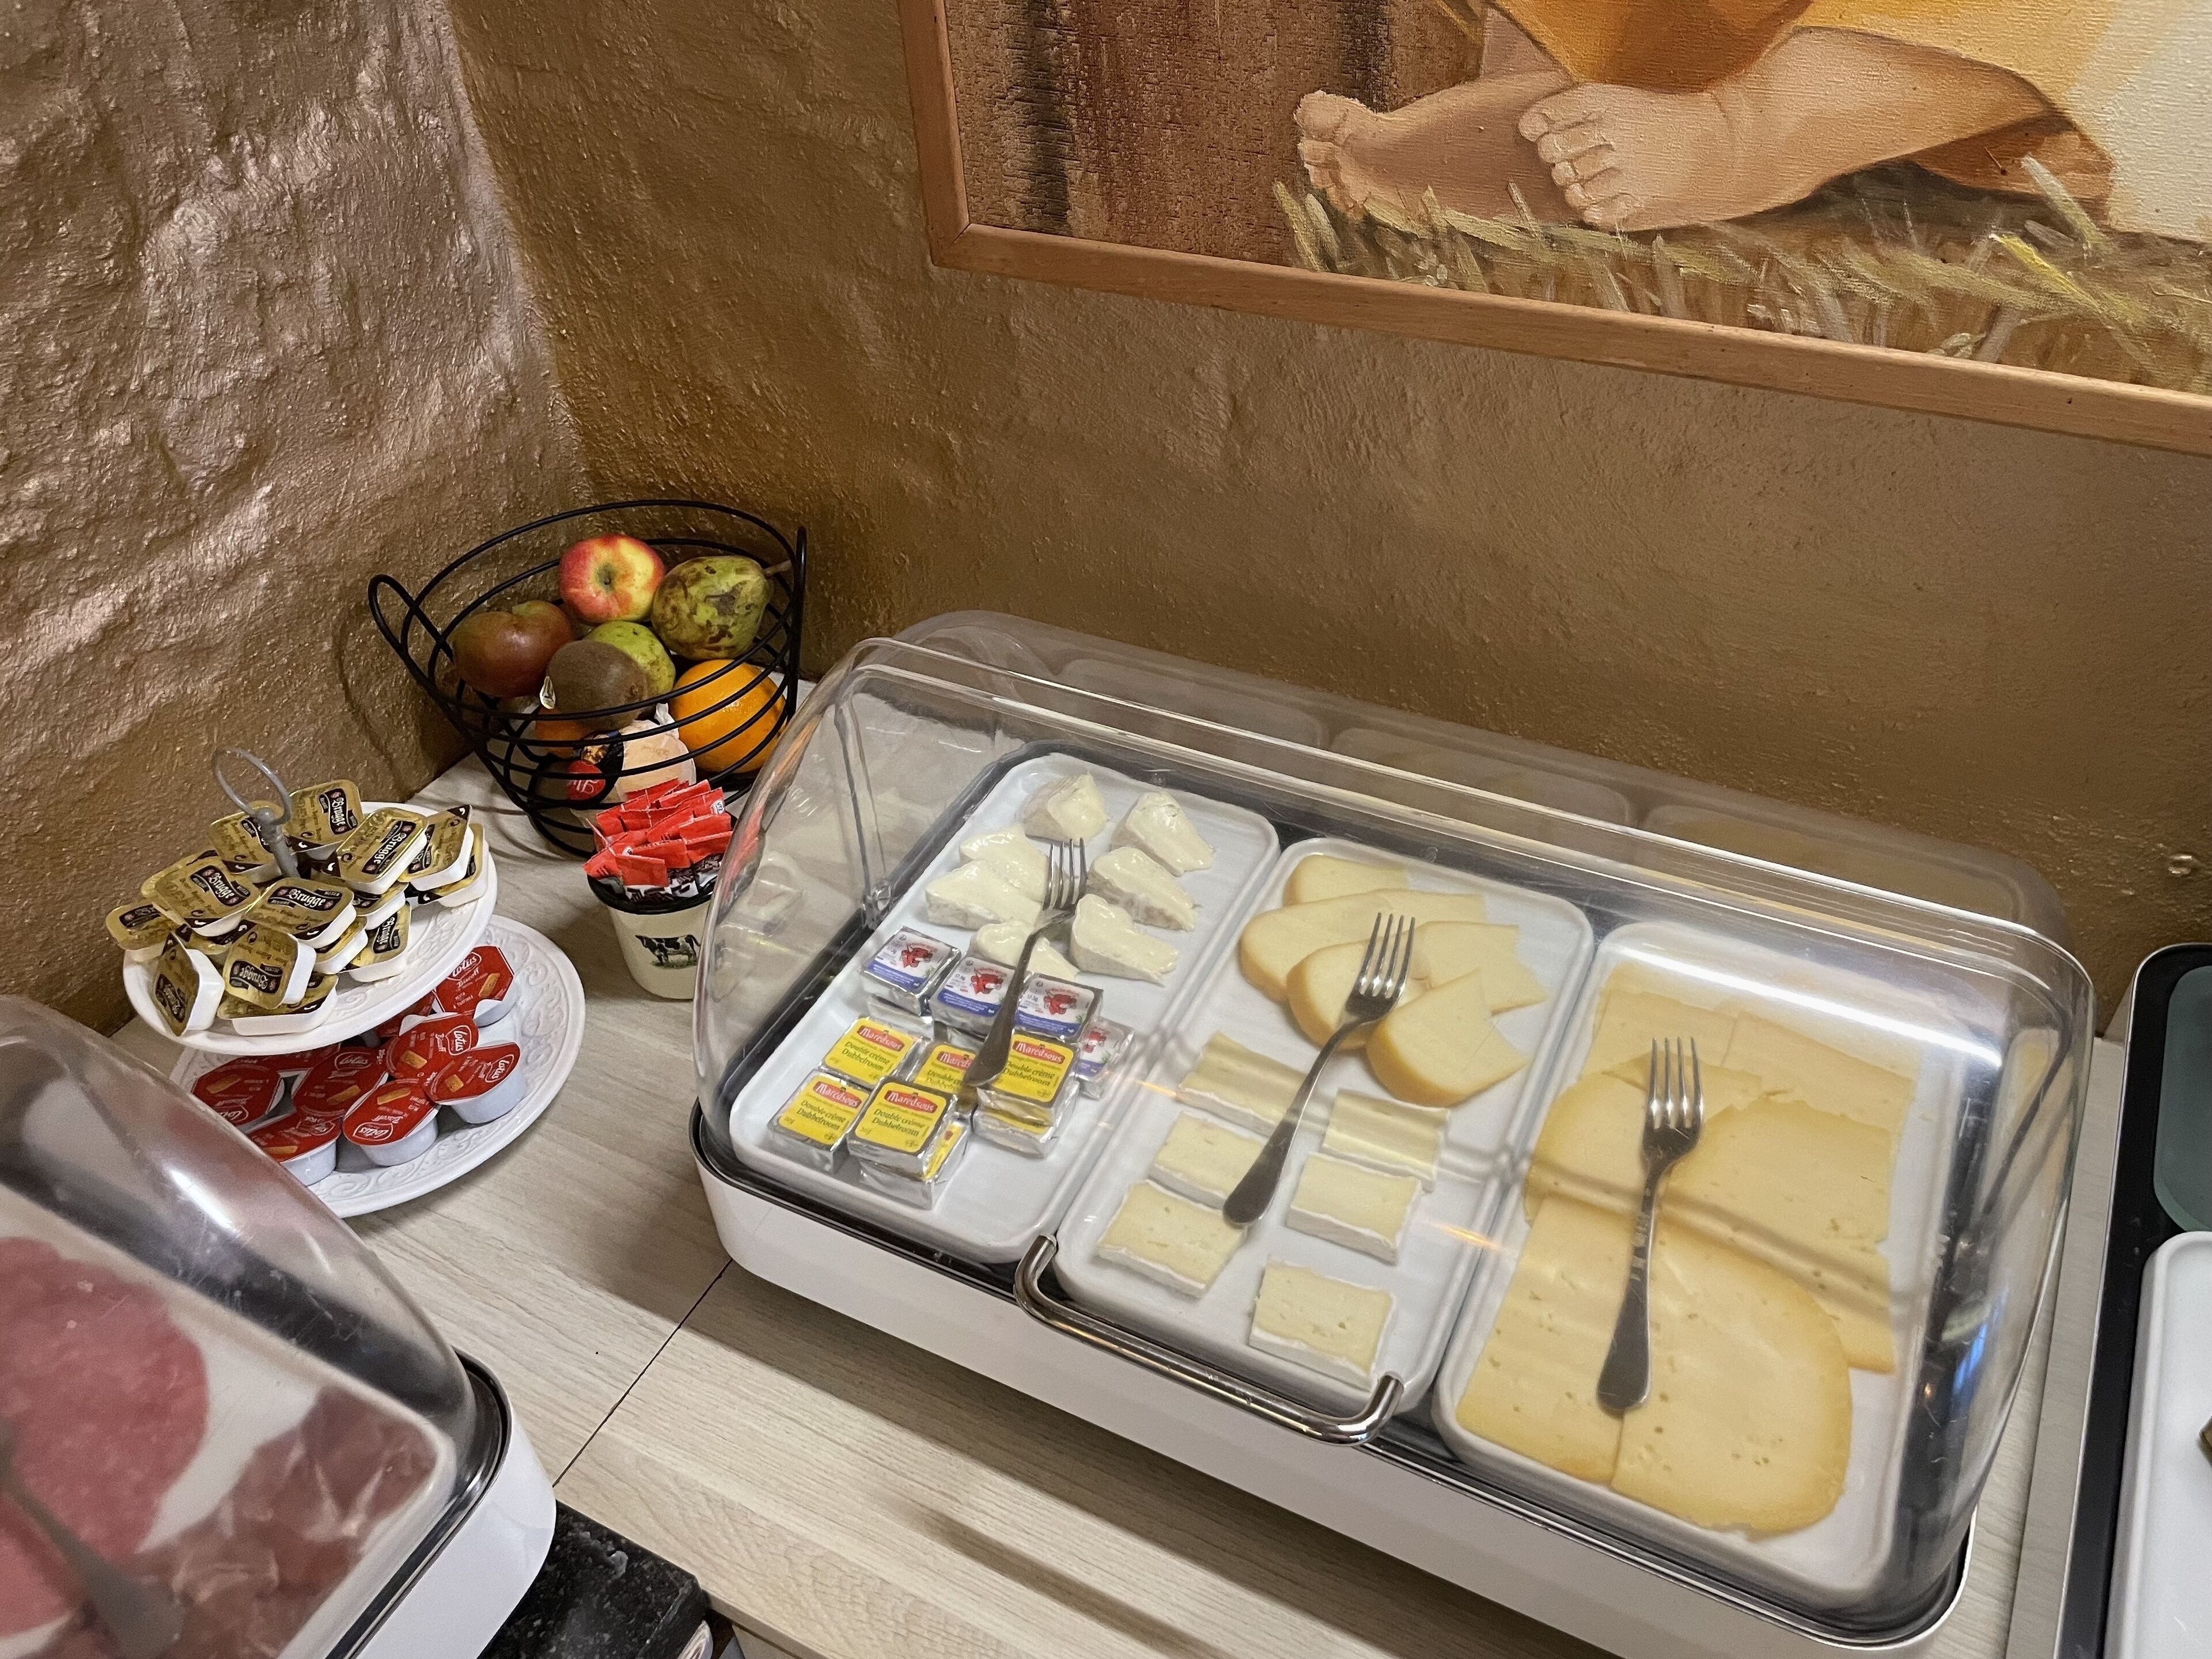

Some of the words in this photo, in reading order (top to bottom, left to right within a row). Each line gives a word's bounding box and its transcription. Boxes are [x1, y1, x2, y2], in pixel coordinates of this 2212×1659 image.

[331, 796, 346, 826] Brugge
[373, 832, 407, 865] Brugge
[208, 872, 236, 899] Brugge
[287, 888, 327, 908] Brugge
[240, 964, 268, 990] Brugge
[844, 1041, 870, 1055] Double
[858, 1027, 902, 1051] Maredsous
[841, 1047, 885, 1071] Dubbelroom
[1015, 1042, 1063, 1063] Maredsous
[1003, 1067, 1051, 1086] Dubbelroom
[815, 1084, 859, 1108] Maredsous
[887, 1091, 935, 1112] Maredsous
[801, 1100, 825, 1115] Double
[873, 1108, 902, 1122] Double
[797, 1108, 840, 1130] Dubbelroom
[872, 1117, 920, 1137] Dubbelroom
